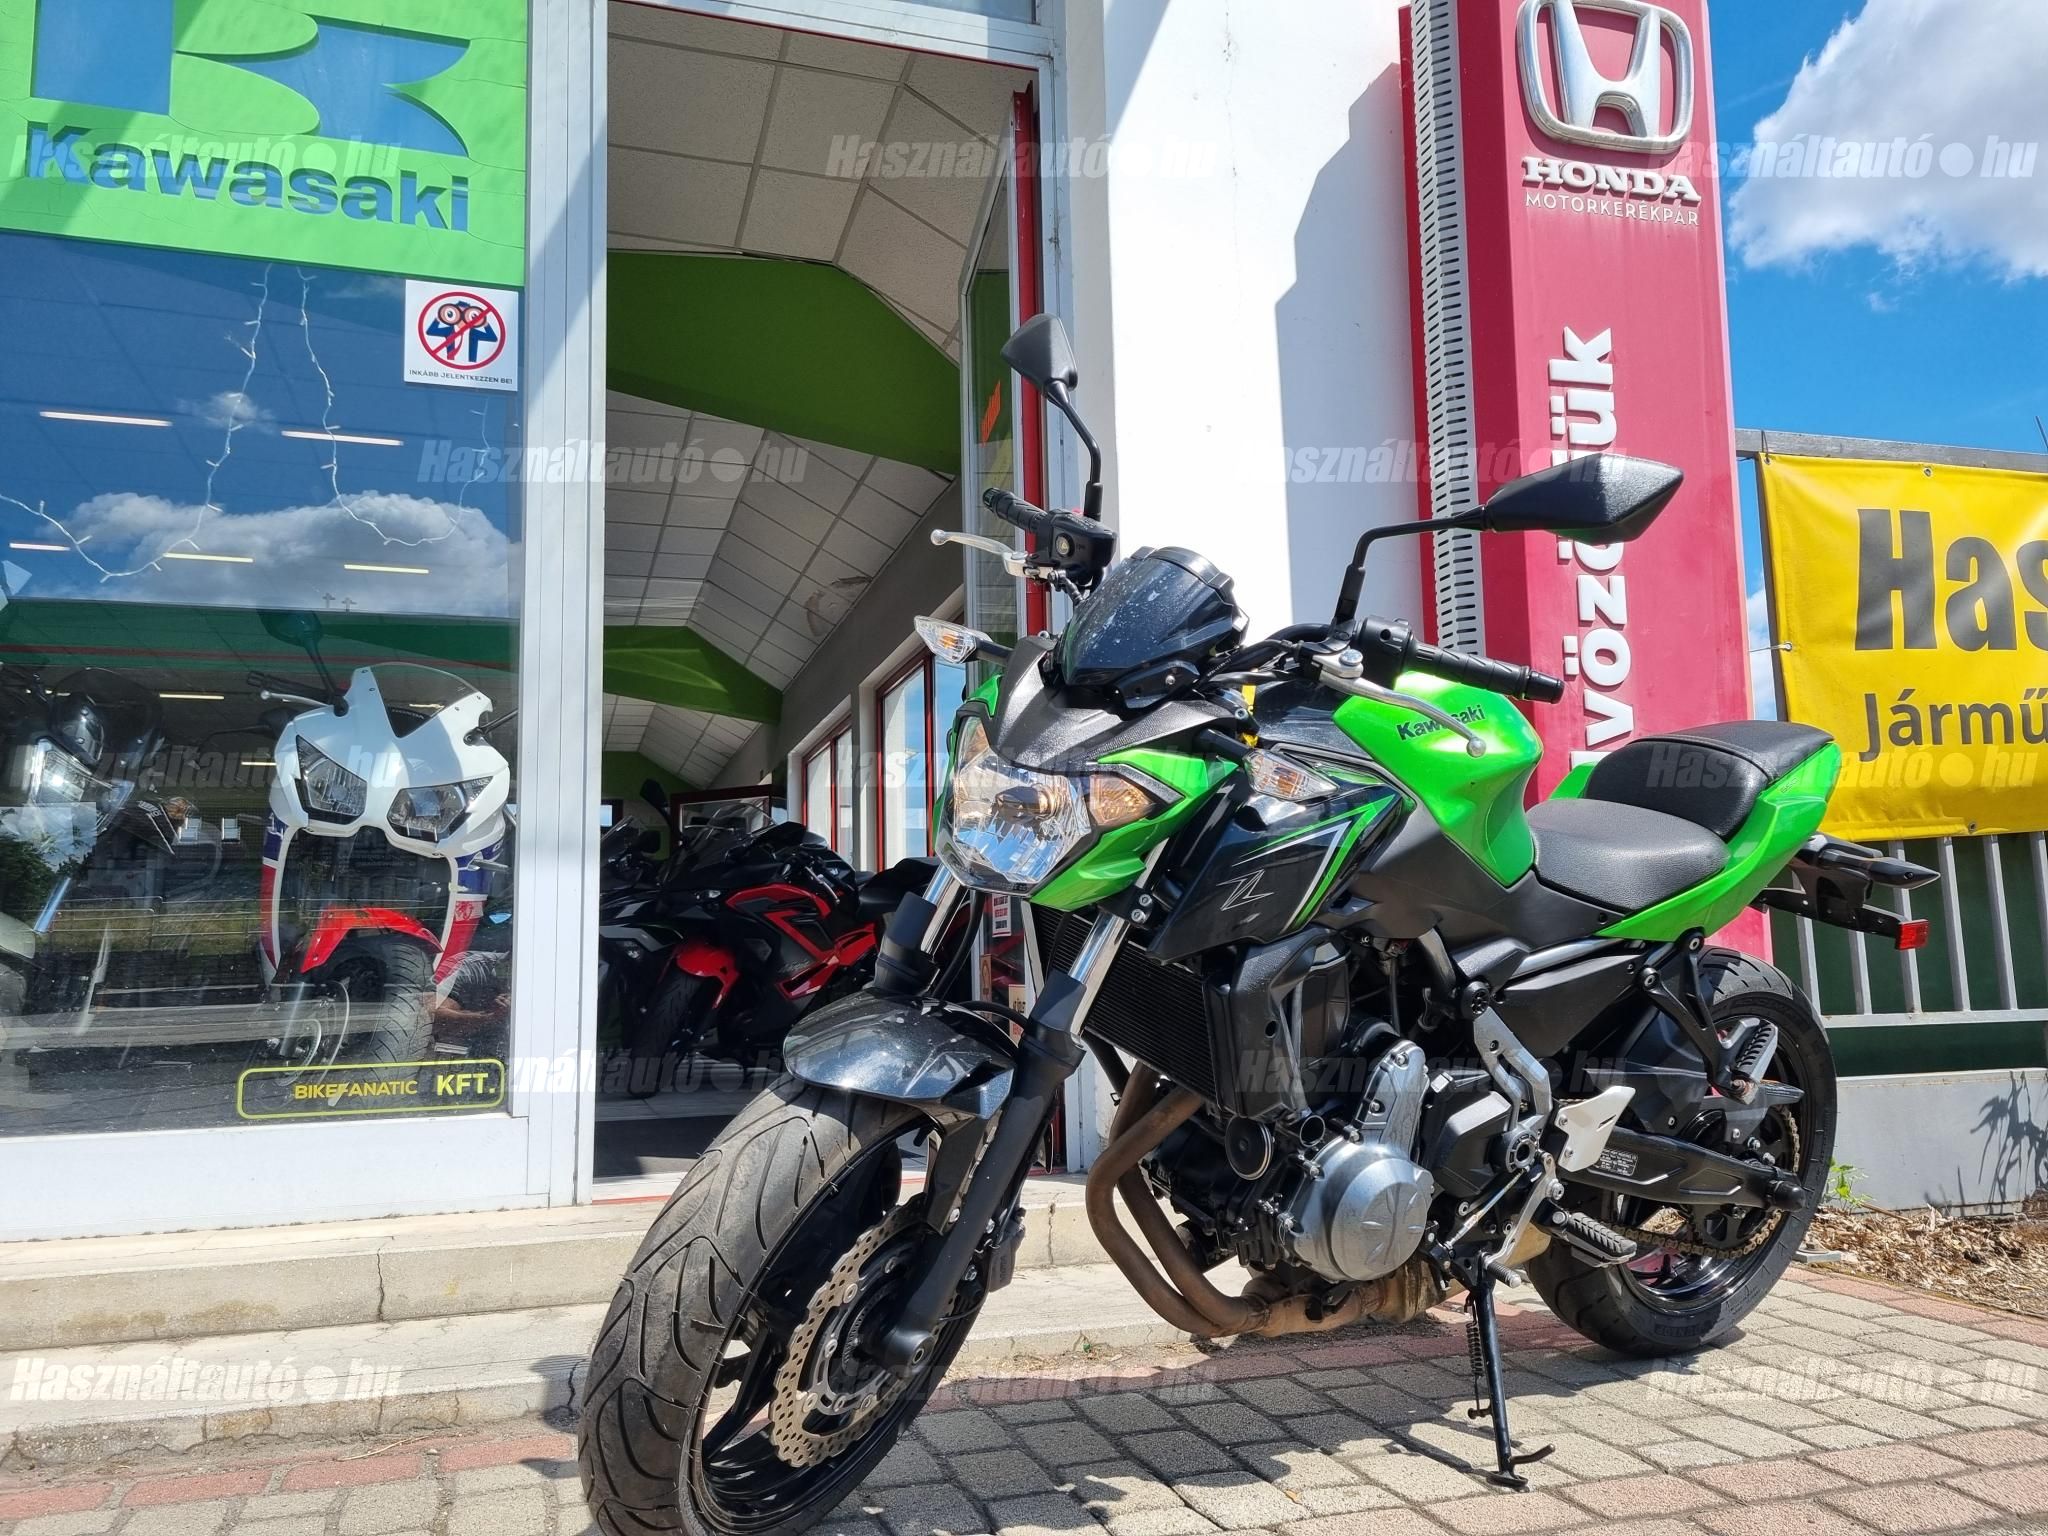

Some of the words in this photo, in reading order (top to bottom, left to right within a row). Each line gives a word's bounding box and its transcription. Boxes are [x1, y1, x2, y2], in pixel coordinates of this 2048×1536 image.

[26, 119, 468, 232] Kawasaki
[1523, 156, 1702, 203] HONDA
[1525, 191, 1699, 226] MOTORKERÉKPÁR
[1397, 704, 1485, 741] Kawaki
[294, 1080, 419, 1100] BIKEFANATIC
[436, 1072, 496, 1096] KFT.
